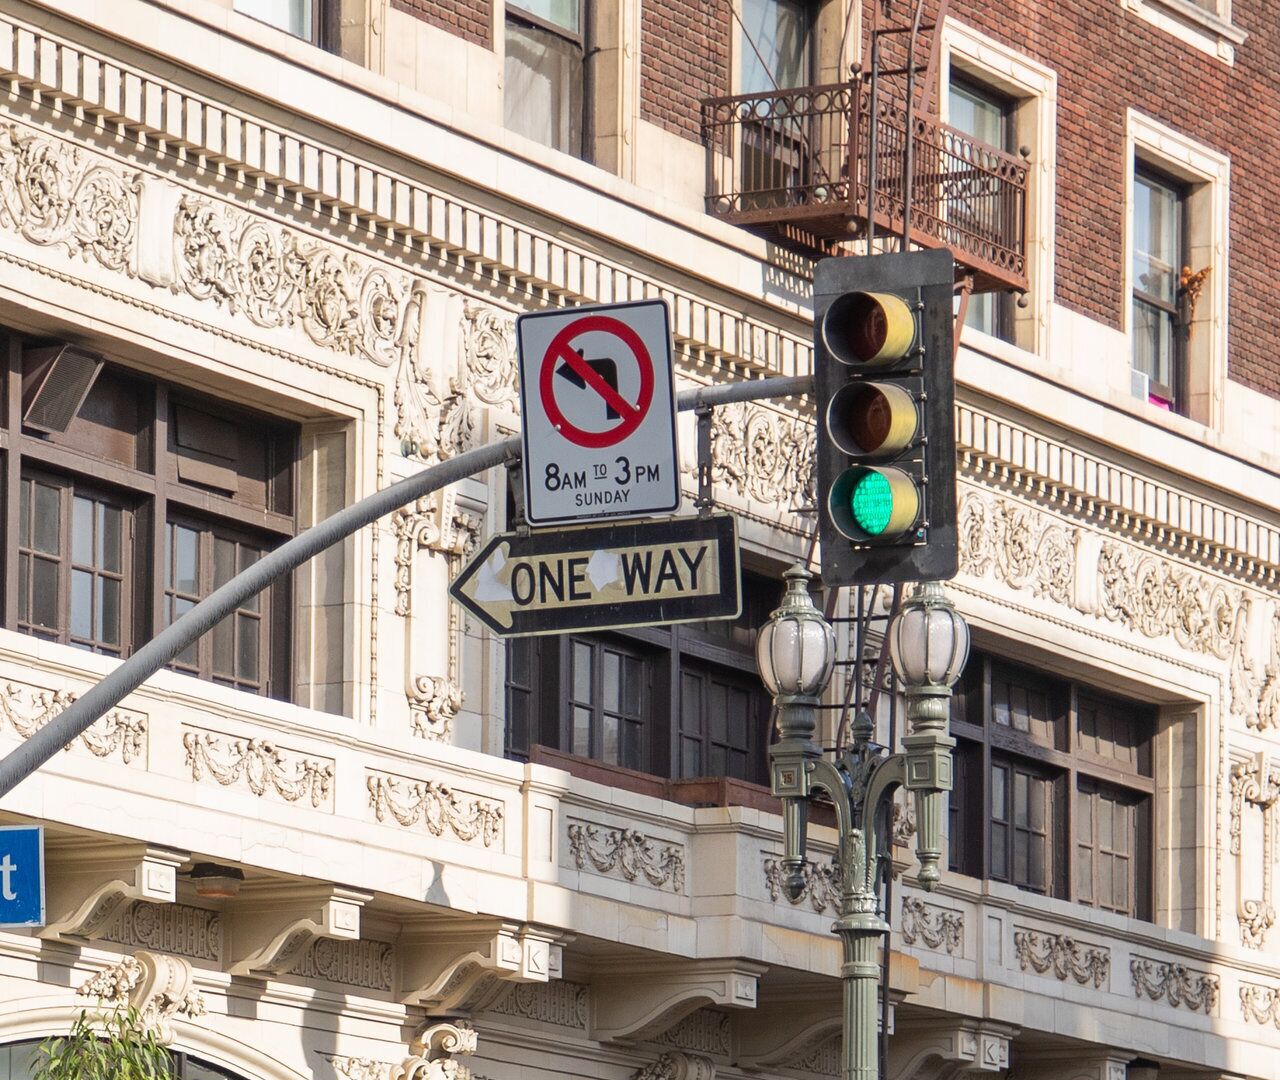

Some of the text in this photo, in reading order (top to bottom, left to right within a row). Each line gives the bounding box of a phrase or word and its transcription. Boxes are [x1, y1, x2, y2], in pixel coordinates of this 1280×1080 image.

[544, 462, 586, 491] 8AM
[593, 464, 607, 478] TO
[575, 489, 630, 506] SUNDAY
[511, 546, 708, 606] ONE WAY
